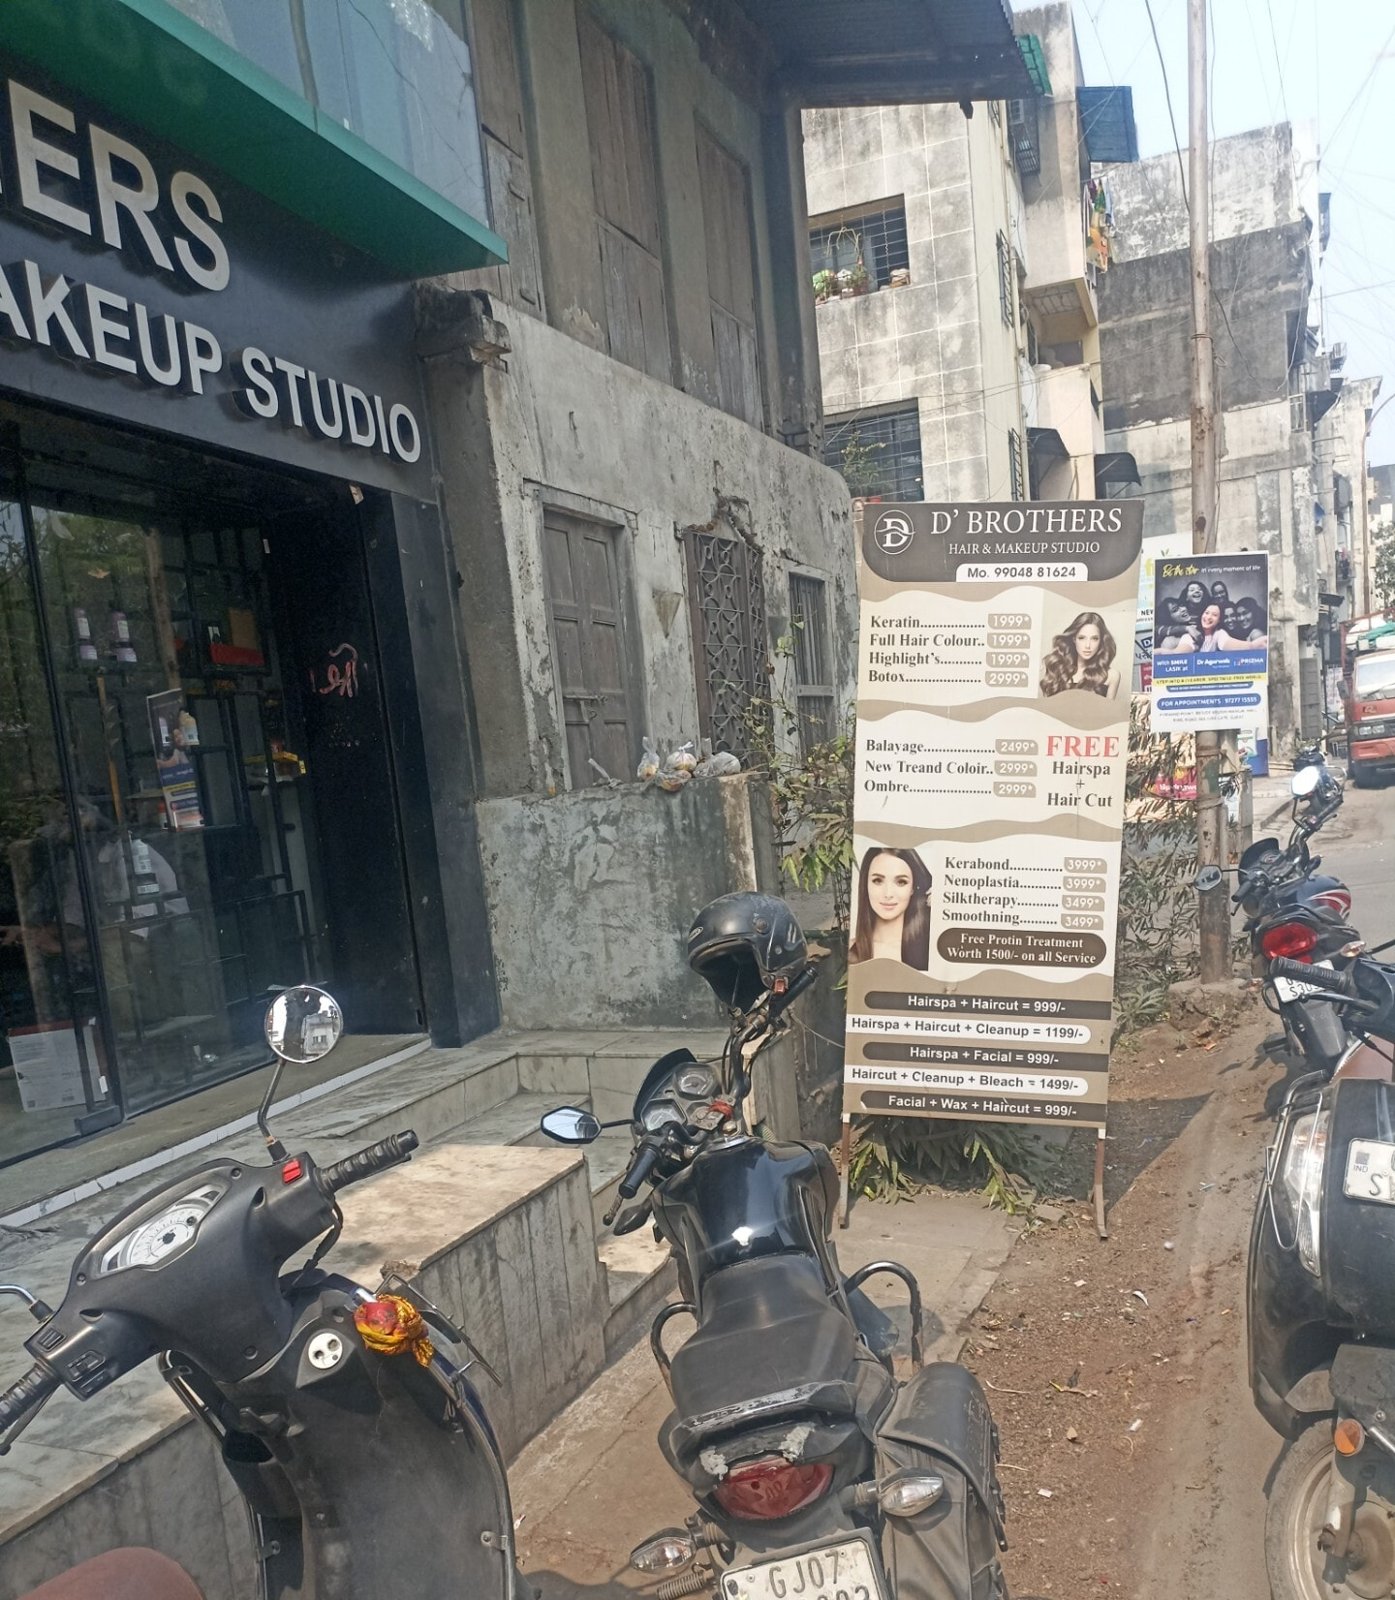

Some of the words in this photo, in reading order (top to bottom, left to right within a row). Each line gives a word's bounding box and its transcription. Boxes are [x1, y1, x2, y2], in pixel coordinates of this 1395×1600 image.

[0, 78, 231, 292] ERS
[241, 347, 422, 463] STUDIO
[967, 507, 1122, 535] BROTHERS
[949, 543, 979, 555] HAIR
[982, 544, 992, 554] &
[995, 543, 1048, 554] MAKEUP
[1050, 541, 1100, 553] STUDIO
[967, 567, 989, 578] Mo.
[994, 566, 1034, 578] 99048
[1037, 565, 1076, 577] 81624
[870, 634, 895, 646] Full
[900, 634, 929, 646] Hair
[1174, 698, 1221, 706] APPOINTMENTS
[1046, 736, 1120, 757] FREE
[865, 760, 892, 772] New
[897, 761, 942, 774] Treand
[1052, 761, 1111, 776] Hairspa
[1047, 792, 1081, 806] Hair
[1085, 793, 1113, 807] Cut
[961, 933, 985, 944] Free
[988, 934, 1022, 946] Protin
[1026, 935, 1083, 948] Treatment
[948, 947, 982, 959] Worth
[985, 948, 1019, 960] 1500/-
[1021, 951, 1035, 961] on
[1038, 950, 1052, 961] all
[1055, 952, 1096, 964] Service
[908, 995, 957, 1009] Hairspa
[960, 999, 969, 1008] +
[972, 998, 1019, 1012] Haircut
[1034, 1001, 1066, 1013] 999/-
[852, 1018, 900, 1031] Hairspa
[903, 1021, 912, 1030] +
[914, 1021, 961, 1034] Haircut
[964, 1024, 973, 1032] +
[975, 1023, 1029, 1037] Cleanup
[1045, 1027, 1083, 1039] 1199/-
[910, 1047, 958, 1060] Hairspa
[962, 1051, 970, 1060] +
[974, 1050, 1012, 1062] Facial
[1027, 1053, 1059, 1065] 999/-
[852, 1068, 898, 1081] Haircut
[901, 1072, 909, 1080] +
[912, 1071, 965, 1085] Cleanup
[968, 1076, 976, 1084] +
[979, 1075, 1024, 1088] Bleach
[1040, 1078, 1078, 1091] 1499/-
[888, 1095, 926, 1108] Facial
[929, 1099, 938, 1108] +
[941, 1098, 968, 1111] Wax
[971, 1102, 979, 1110] +
[983, 1101, 1030, 1115] Haircut
[1045, 1104, 1077, 1116] 999/-
